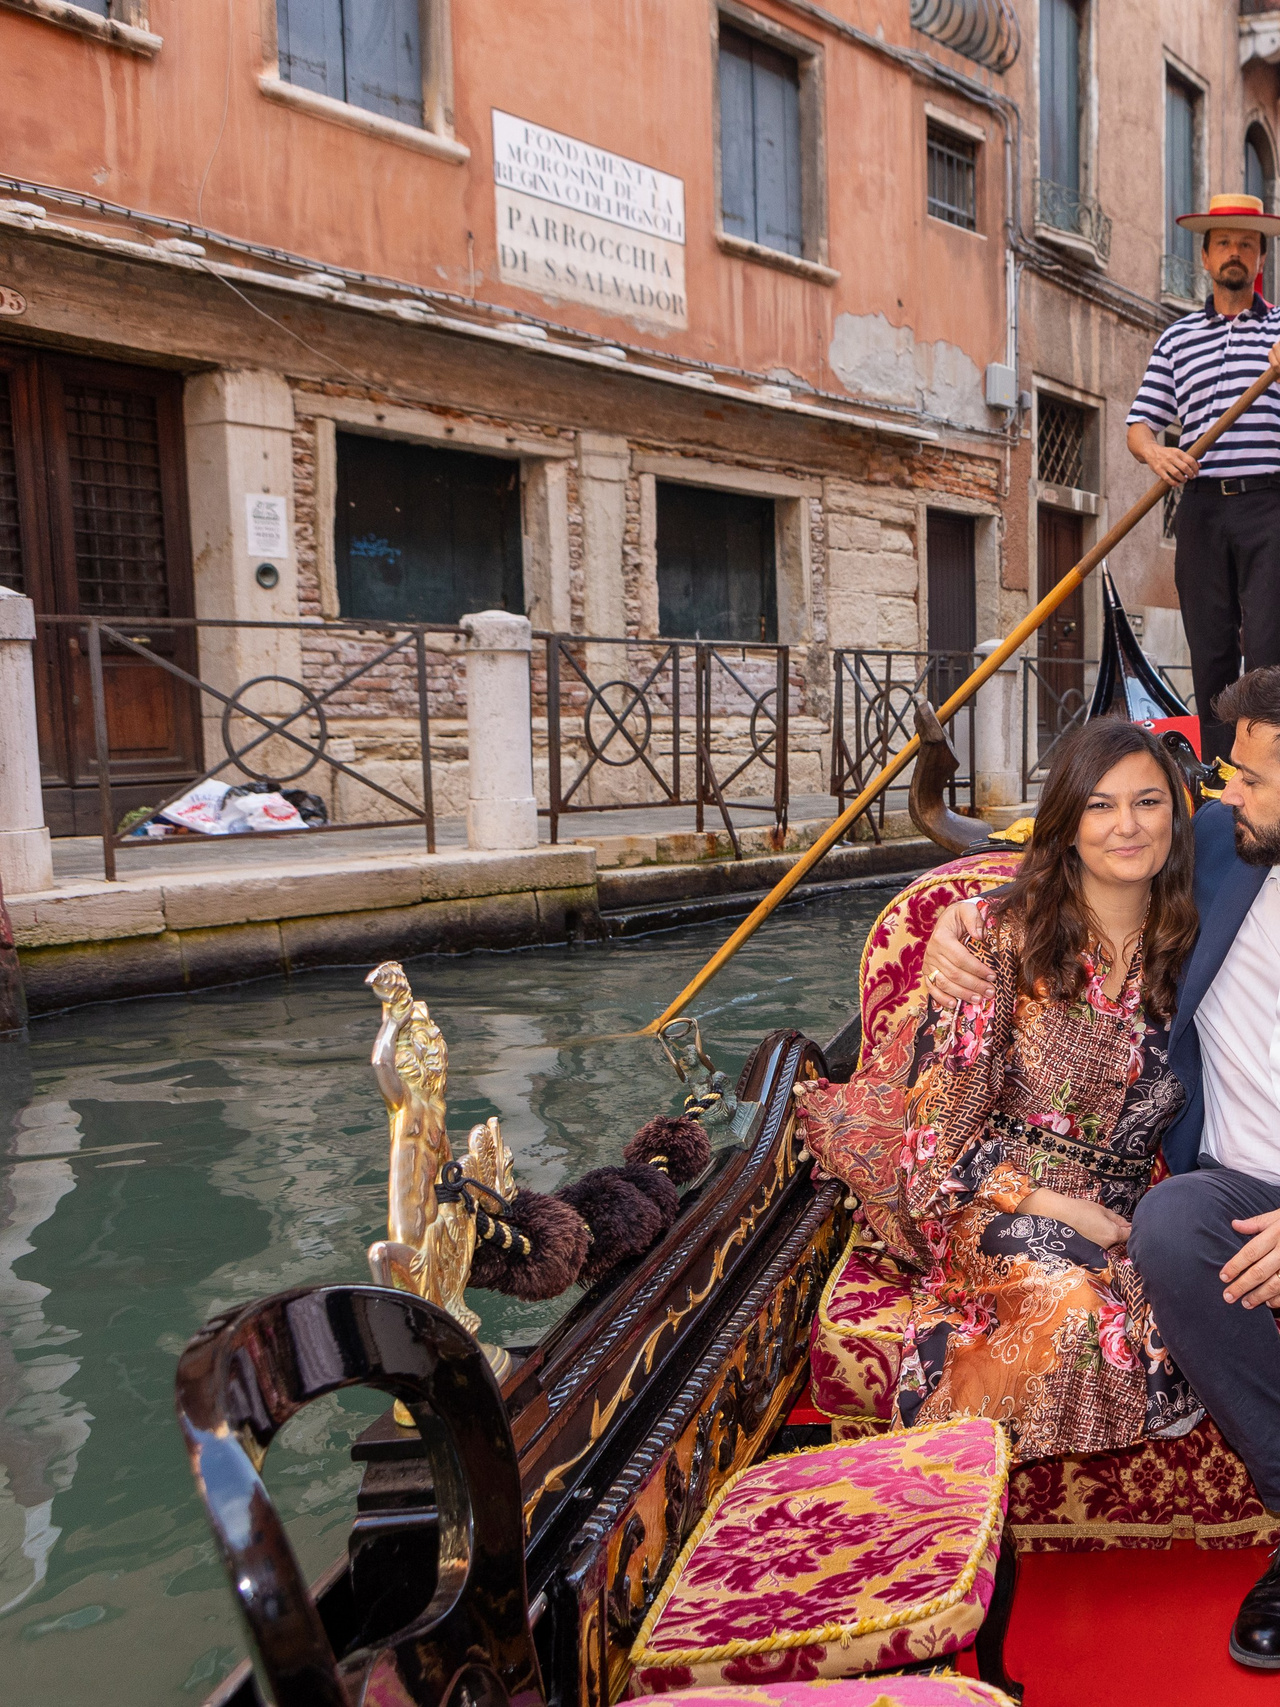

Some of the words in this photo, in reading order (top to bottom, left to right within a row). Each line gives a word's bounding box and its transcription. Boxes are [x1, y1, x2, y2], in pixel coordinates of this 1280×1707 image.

[507, 141, 605, 193] MOROSINI
[614, 179, 639, 204] DE
[651, 192, 674, 216] LA
[523, 126, 659, 193] FONDAMENTA
[496, 160, 561, 199] REGINA
[565, 184, 581, 204] O
[615, 200, 683, 238] PIGNOLI
[501, 243, 530, 274] DI
[507, 205, 673, 279] PARROCCHIA
